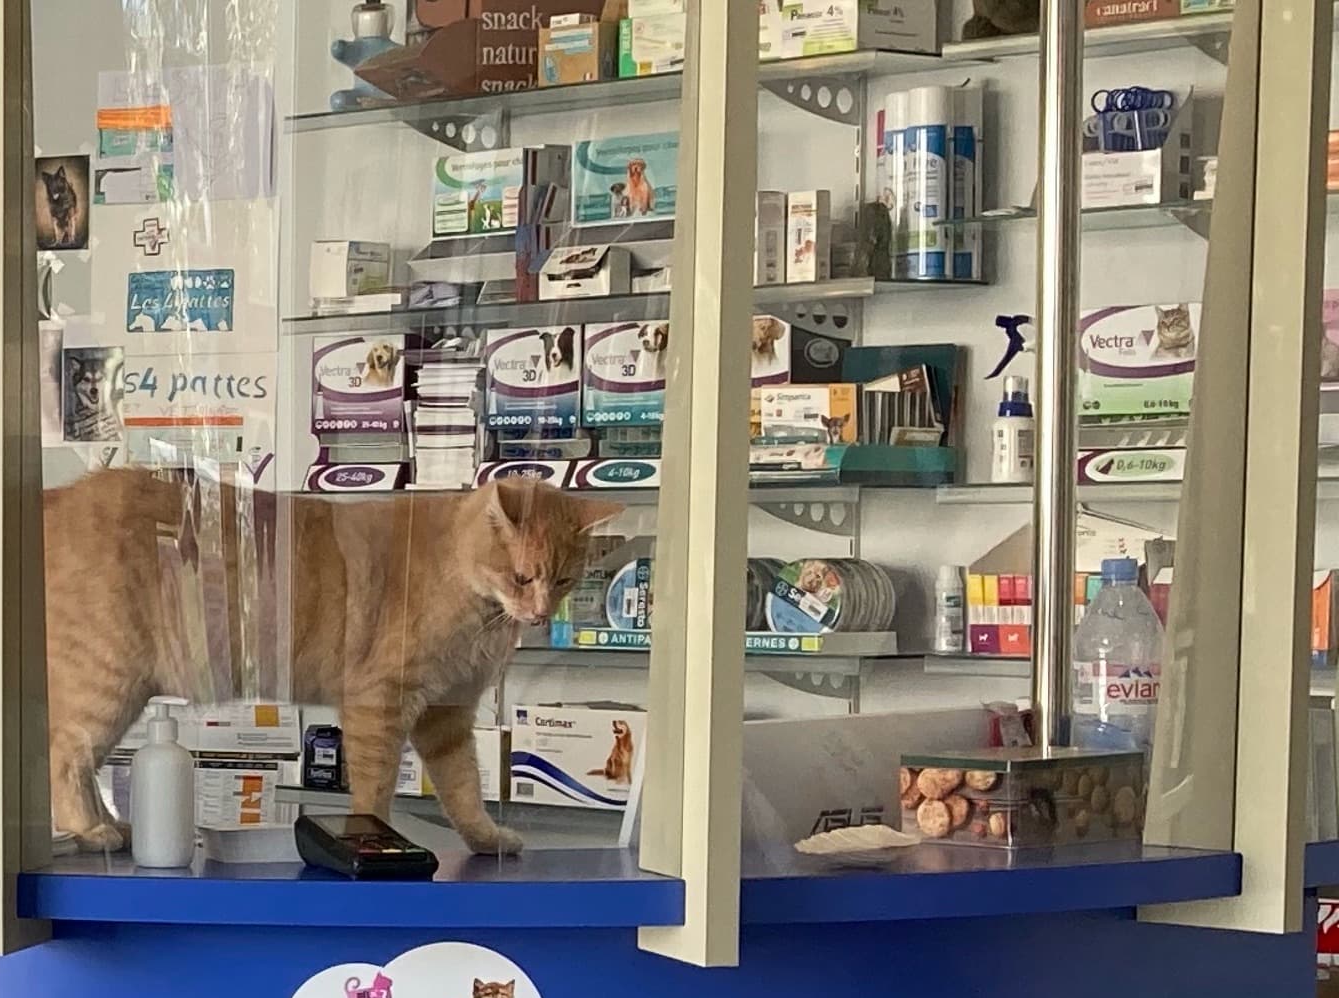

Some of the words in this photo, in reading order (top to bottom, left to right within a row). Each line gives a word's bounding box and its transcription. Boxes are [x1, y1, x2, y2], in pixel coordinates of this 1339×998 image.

[481, 4, 544, 31] snack
[1090, 335, 1134, 349] Vectra
[494, 358, 525, 371] Vectra
[622, 364, 637, 377] 3D
[348, 376, 362, 388] 3D
[523, 369, 537, 382] 3D
[636, 581, 650, 628] Seresto
